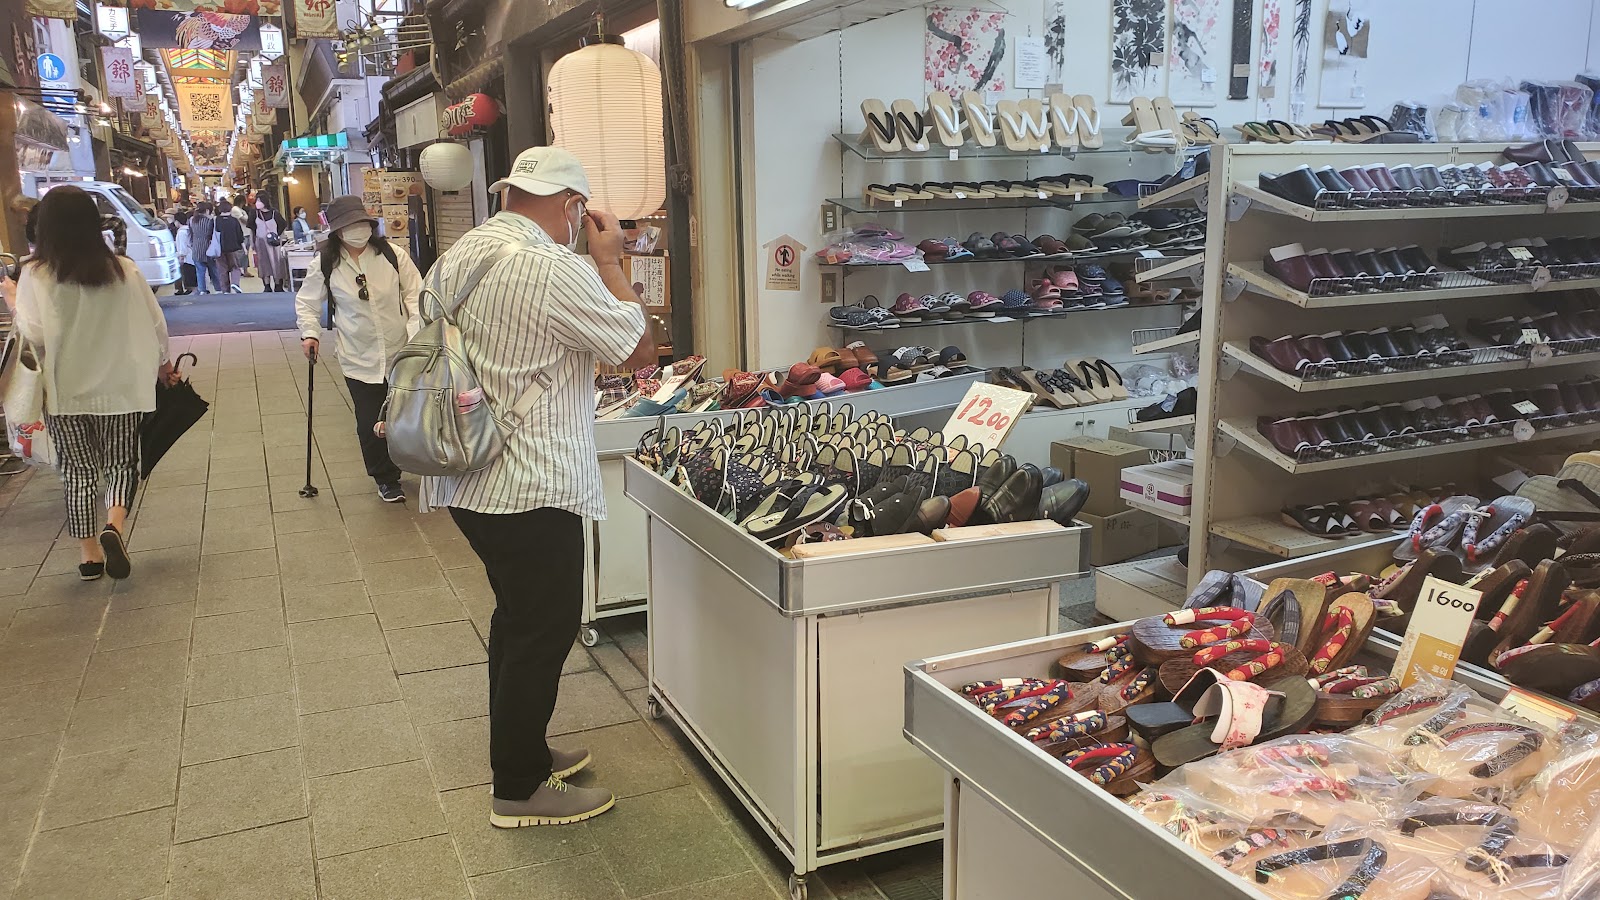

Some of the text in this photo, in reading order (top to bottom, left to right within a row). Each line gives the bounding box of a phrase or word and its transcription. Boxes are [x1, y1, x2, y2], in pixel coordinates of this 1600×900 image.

[107, 59, 131, 84] 錦
[265, 75, 285, 97] 錦
[956, 394, 1011, 431] 1200
[1427, 588, 1475, 612] 1600
